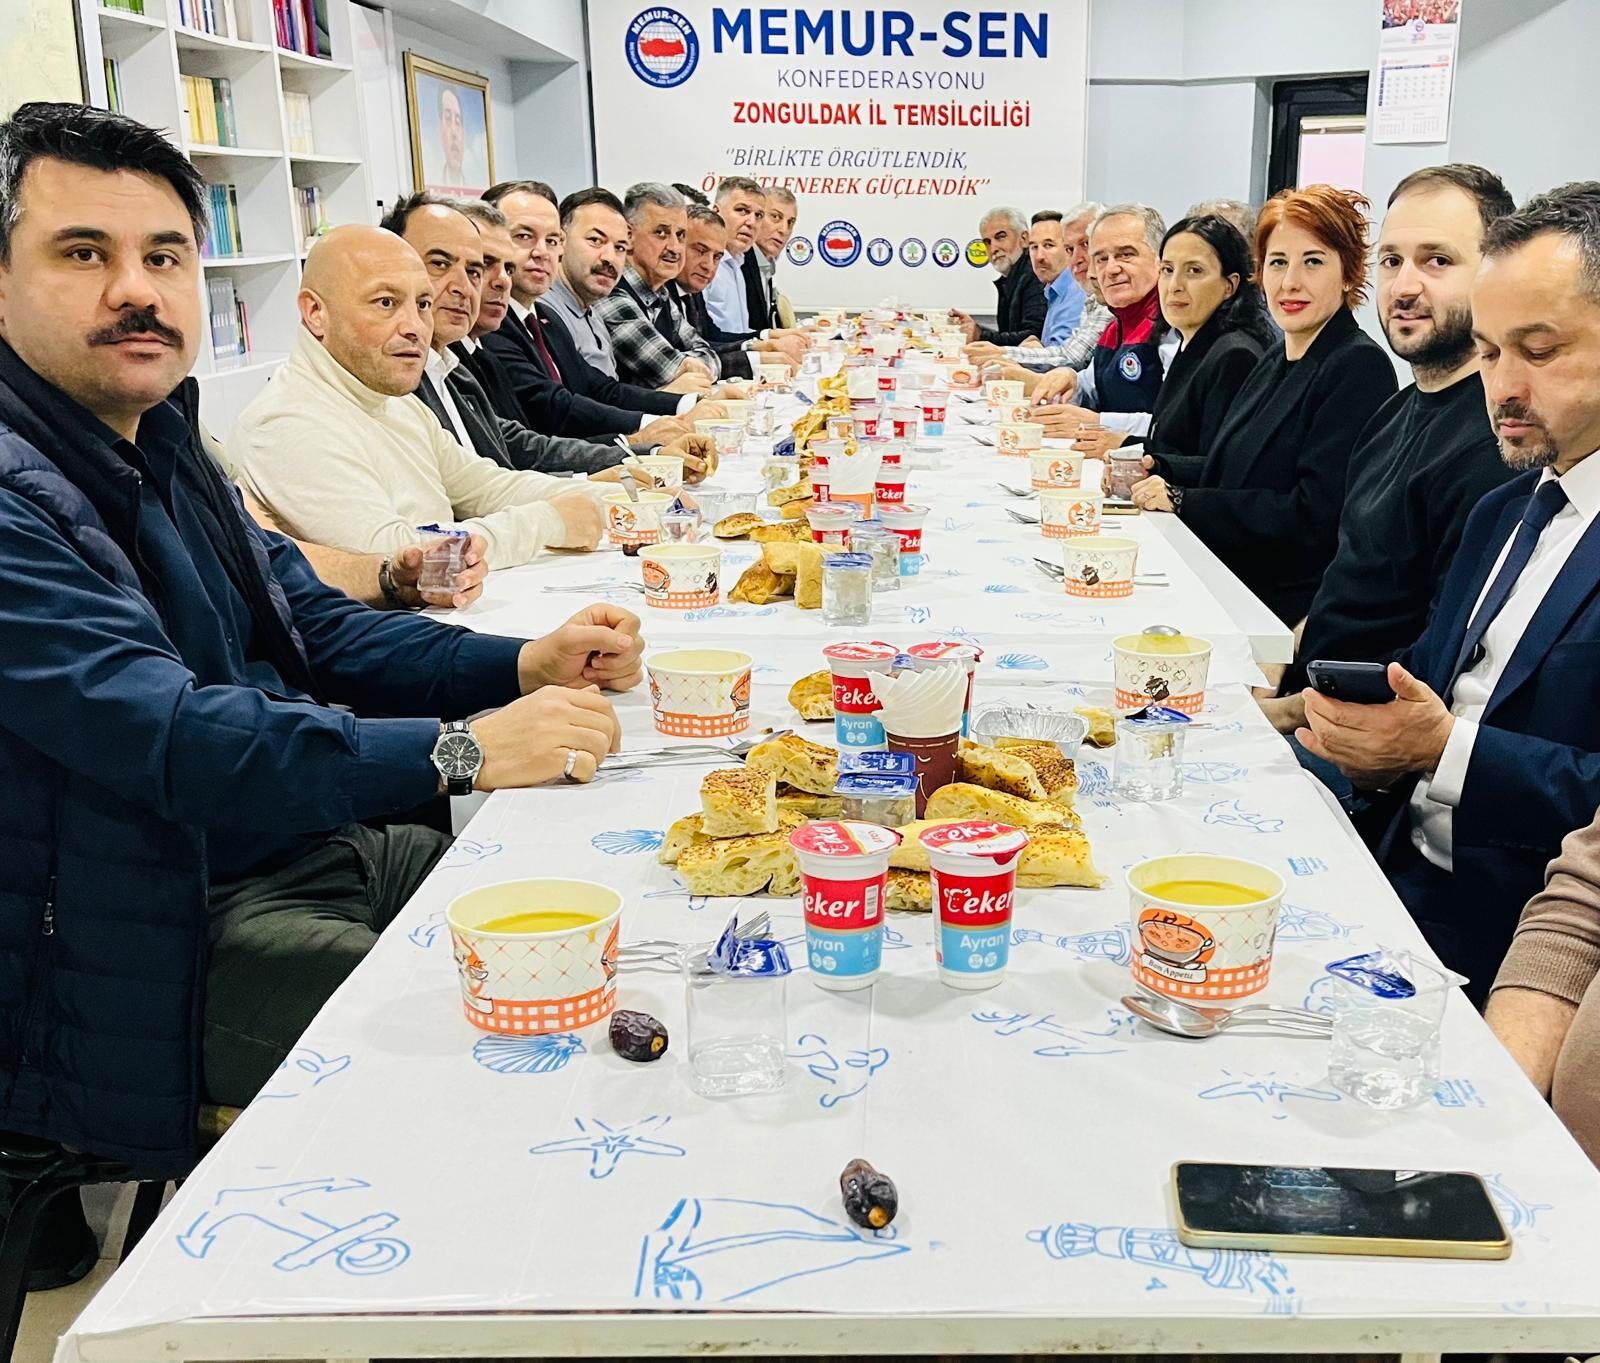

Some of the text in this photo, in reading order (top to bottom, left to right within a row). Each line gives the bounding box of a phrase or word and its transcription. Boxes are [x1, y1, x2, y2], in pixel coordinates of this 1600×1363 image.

[631, 10, 692, 36] MEMUR-SEN
[712, 7, 1048, 58] MEMUR-SEN
[778, 68, 985, 90] KONFEDERASYONU
[733, 98, 1031, 128] ZONGULDAK İL TEMSİLCİLİĞİ
[827, 146, 969, 171] ÖRGÜTLENDİK,
[841, 718, 873, 730] Ayran
[959, 933, 1004, 952] Ayran
